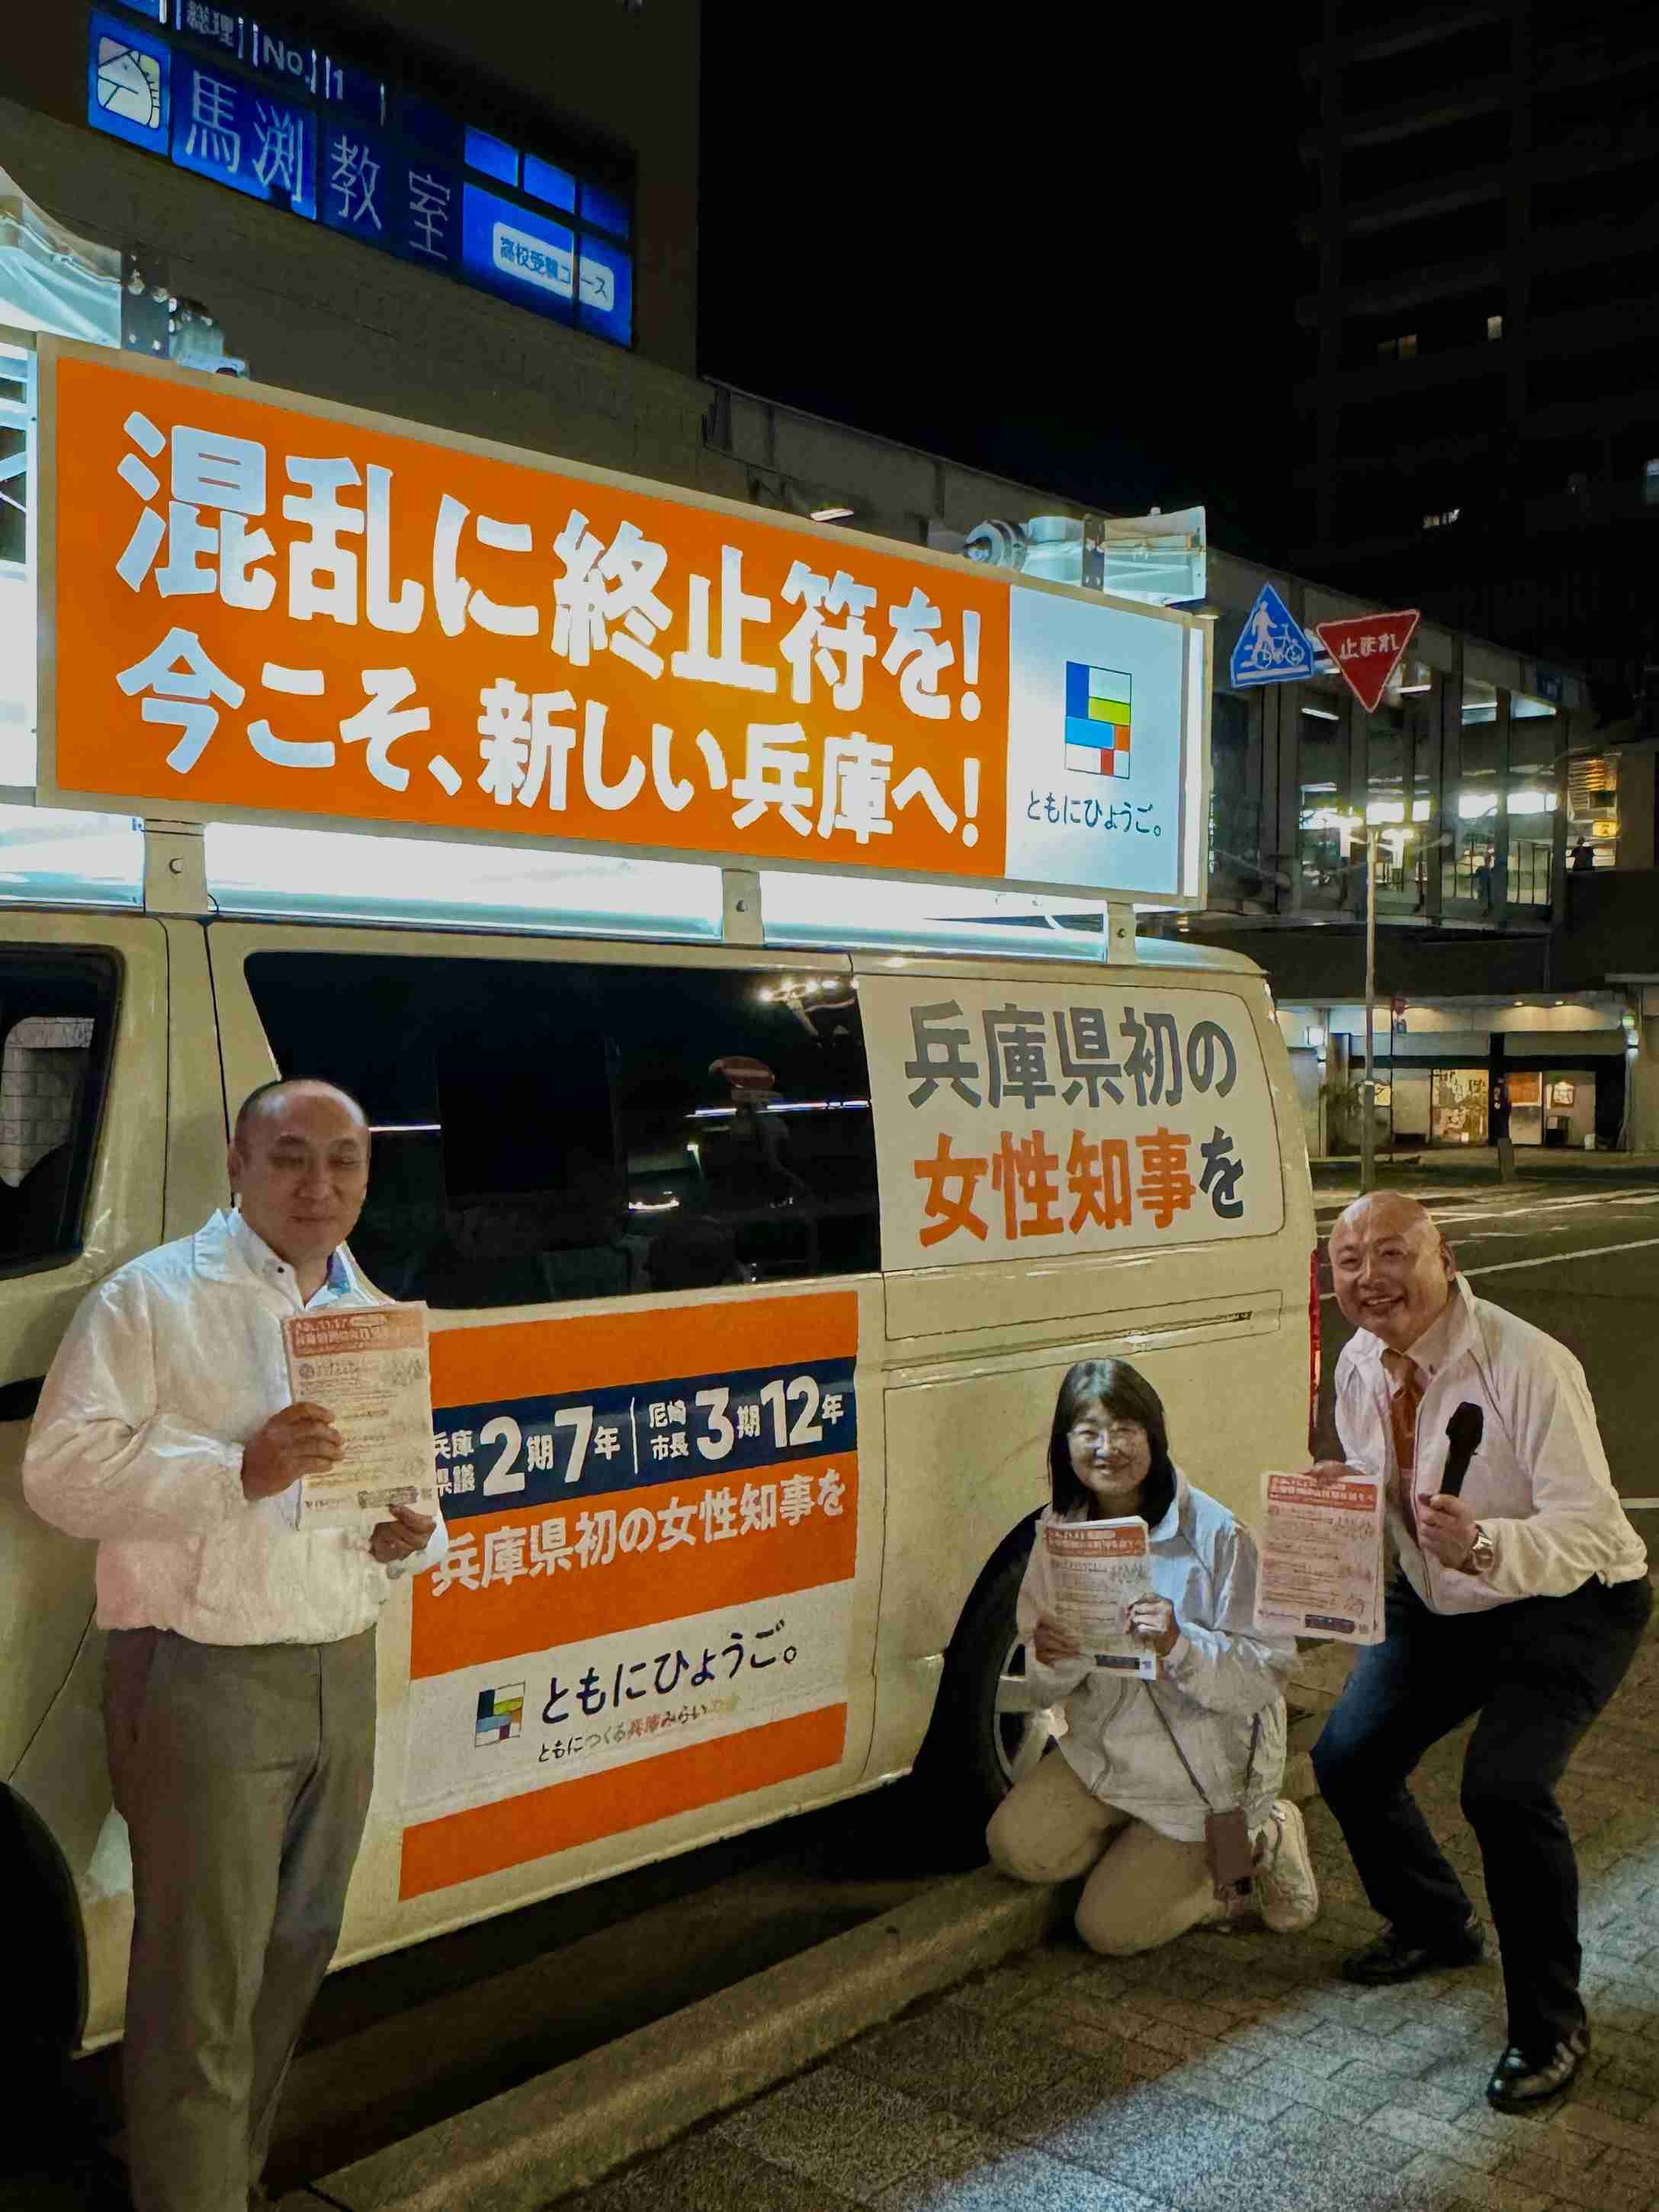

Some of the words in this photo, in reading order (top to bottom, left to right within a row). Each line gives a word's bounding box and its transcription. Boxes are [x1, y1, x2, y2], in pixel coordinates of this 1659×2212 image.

[116, 410, 981, 721] 混乱に終止符を！
[1339, 632, 1401, 660] 止まれ
[1026, 789, 1162, 836] ともにひょうご。
[903, 1000, 1237, 1109] 兵庫県初の
[914, 1125, 1244, 1247] 女性知事を
[431, 1468, 846, 1597] 兵庫県初の女性知事を
[542, 1618, 797, 1724] ともにひょうご。
